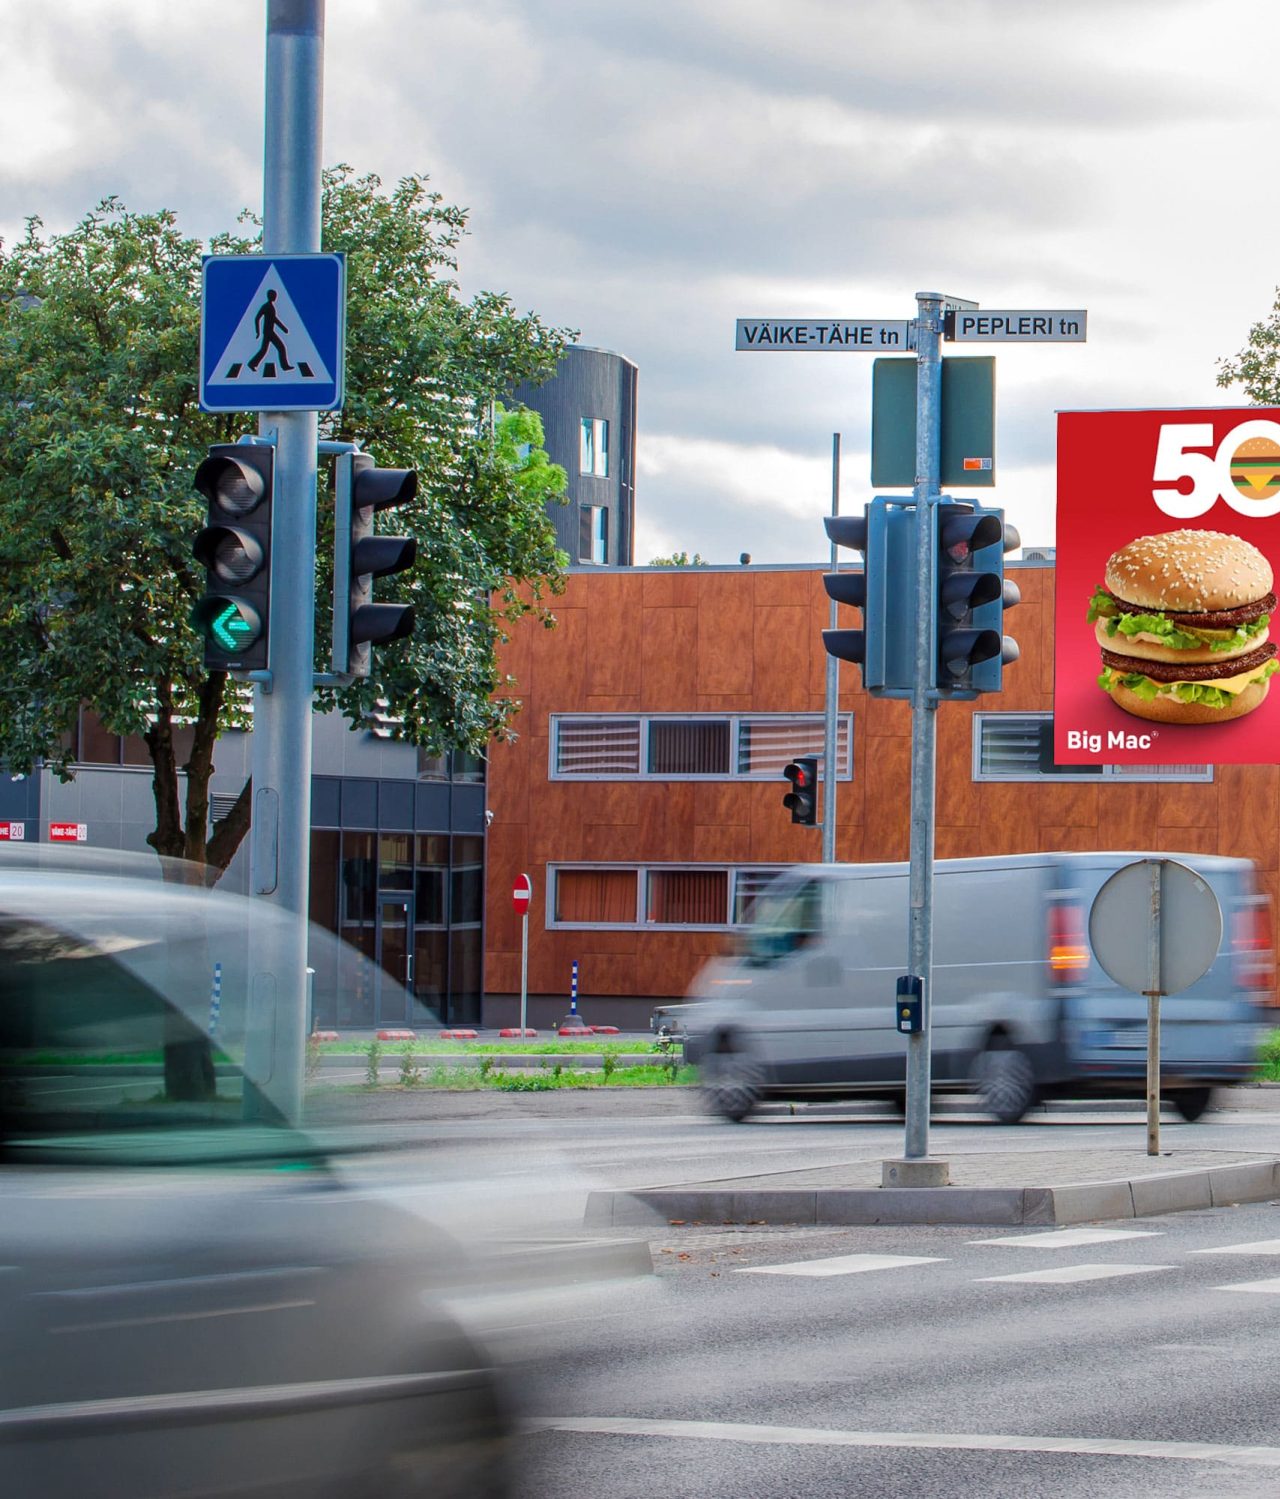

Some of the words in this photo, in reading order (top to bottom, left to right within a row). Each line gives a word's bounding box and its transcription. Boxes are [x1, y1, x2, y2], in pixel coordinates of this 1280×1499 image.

[743, 323, 873, 344] VÄIKE-TÄHE
[879, 328, 899, 344] tn
[962, 317, 1053, 335] PEPLERI
[1059, 318, 1079, 335] tn
[1067, 730, 1102, 753] Big
[12, 825, 23, 837] 20
